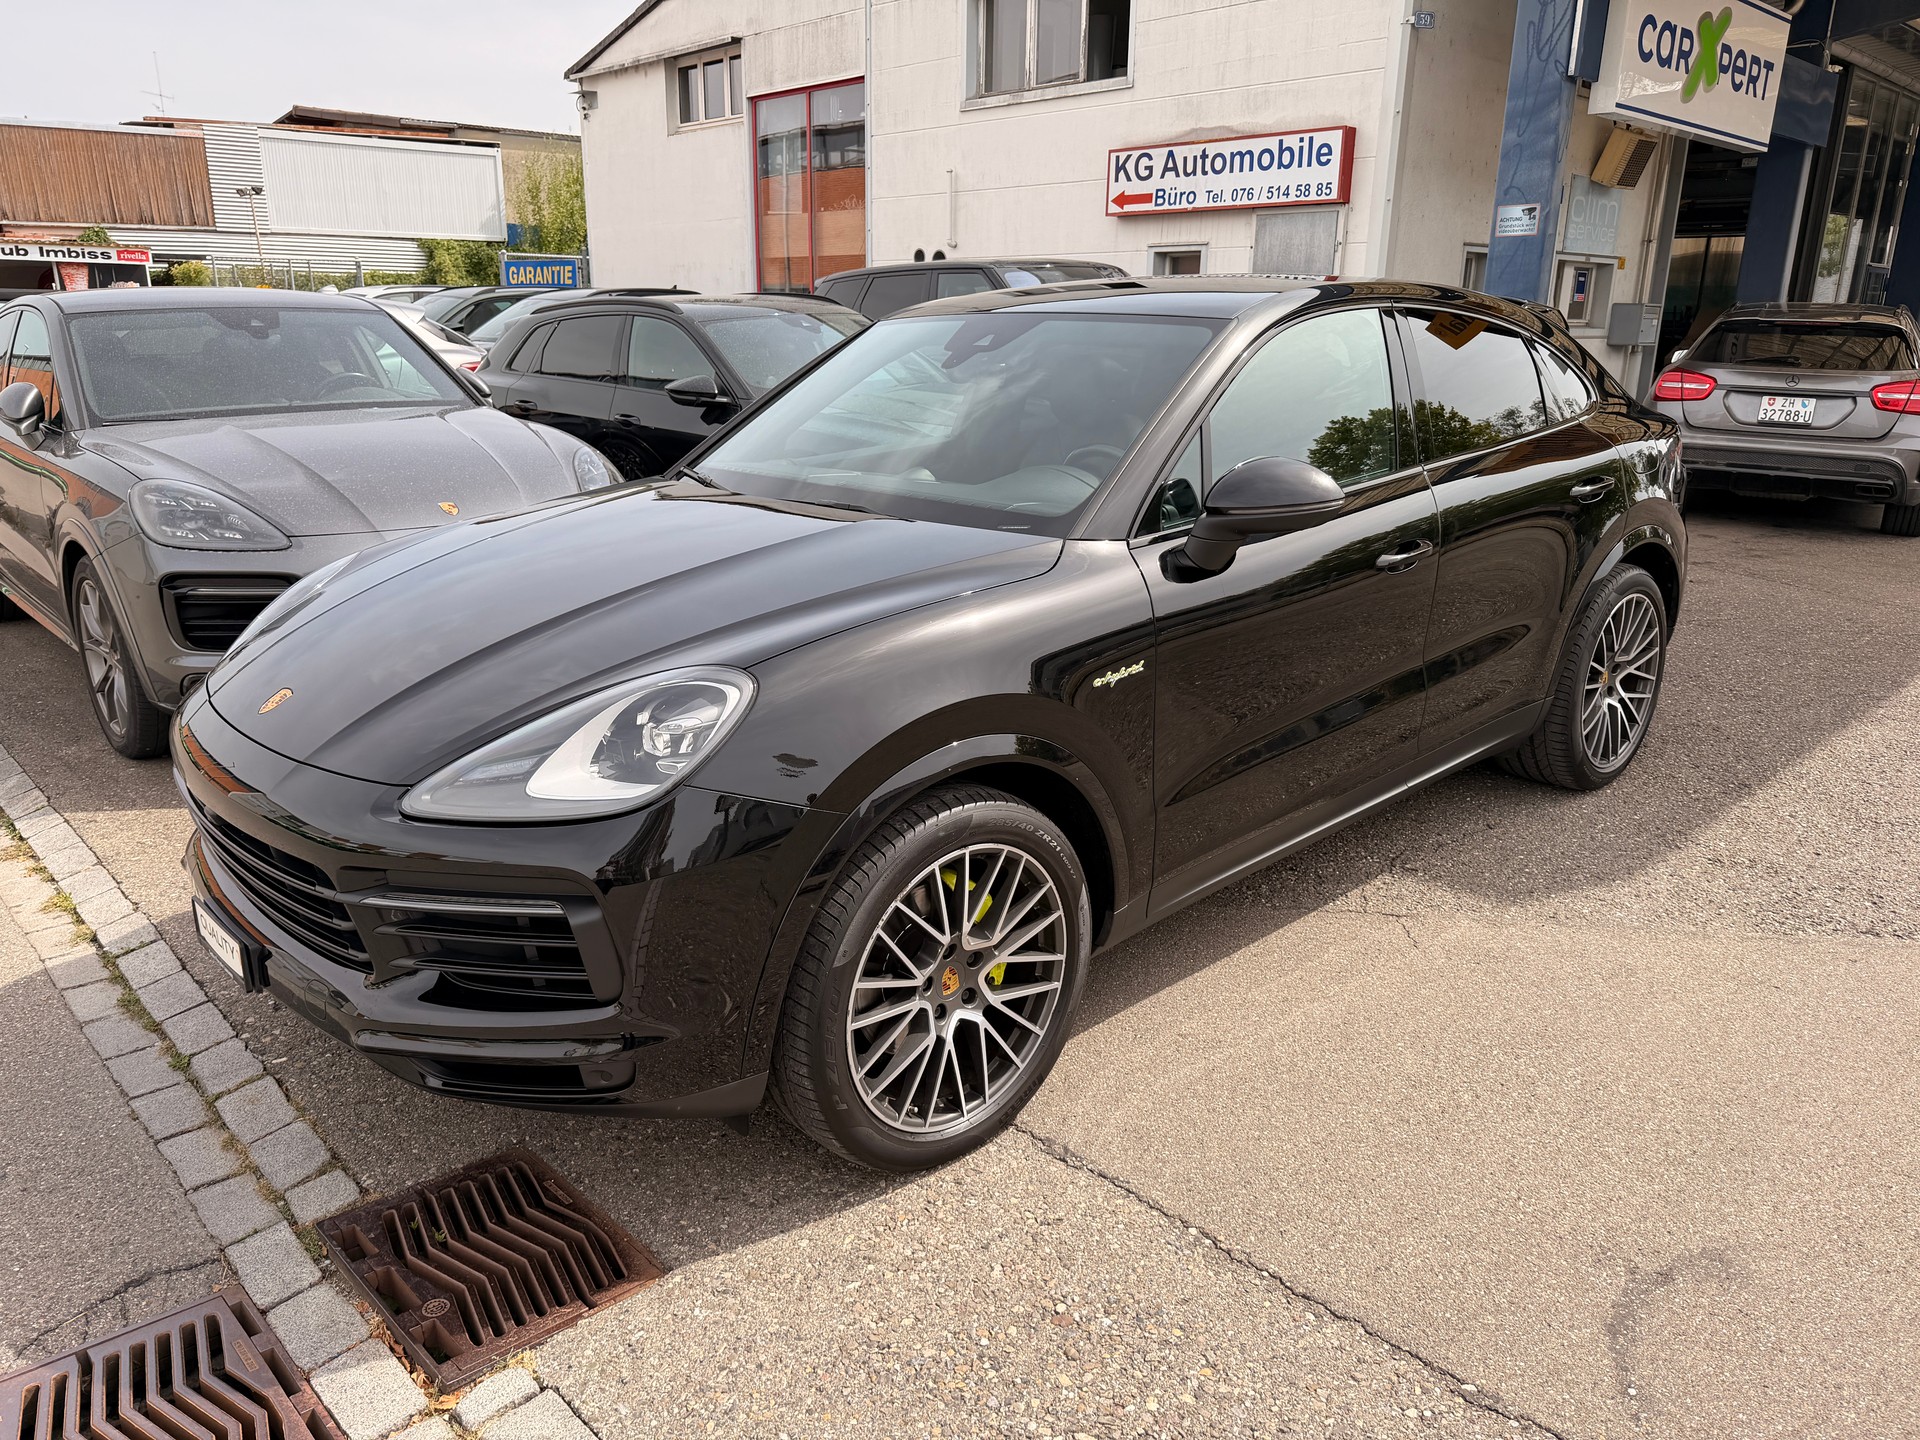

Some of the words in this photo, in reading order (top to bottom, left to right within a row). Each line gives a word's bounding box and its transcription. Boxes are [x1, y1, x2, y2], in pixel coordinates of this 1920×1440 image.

[1114, 152, 1154, 183] KG
[1160, 136, 1333, 179] Automobile
[1154, 187, 1197, 207] Büro
[1205, 189, 1226, 204] Tel.
[1231, 188, 1254, 202] 076
[1266, 185, 1291, 200] 514
[1295, 183, 1311, 198] 58
[1315, 182, 1332, 197] 85
[1568, 223, 1615, 242] service
[38, 246, 113, 260] Imbiss
[120, 252, 146, 260] rivella
[509, 266, 573, 285] GARANTIE
[1781, 398, 1795, 408] ZH
